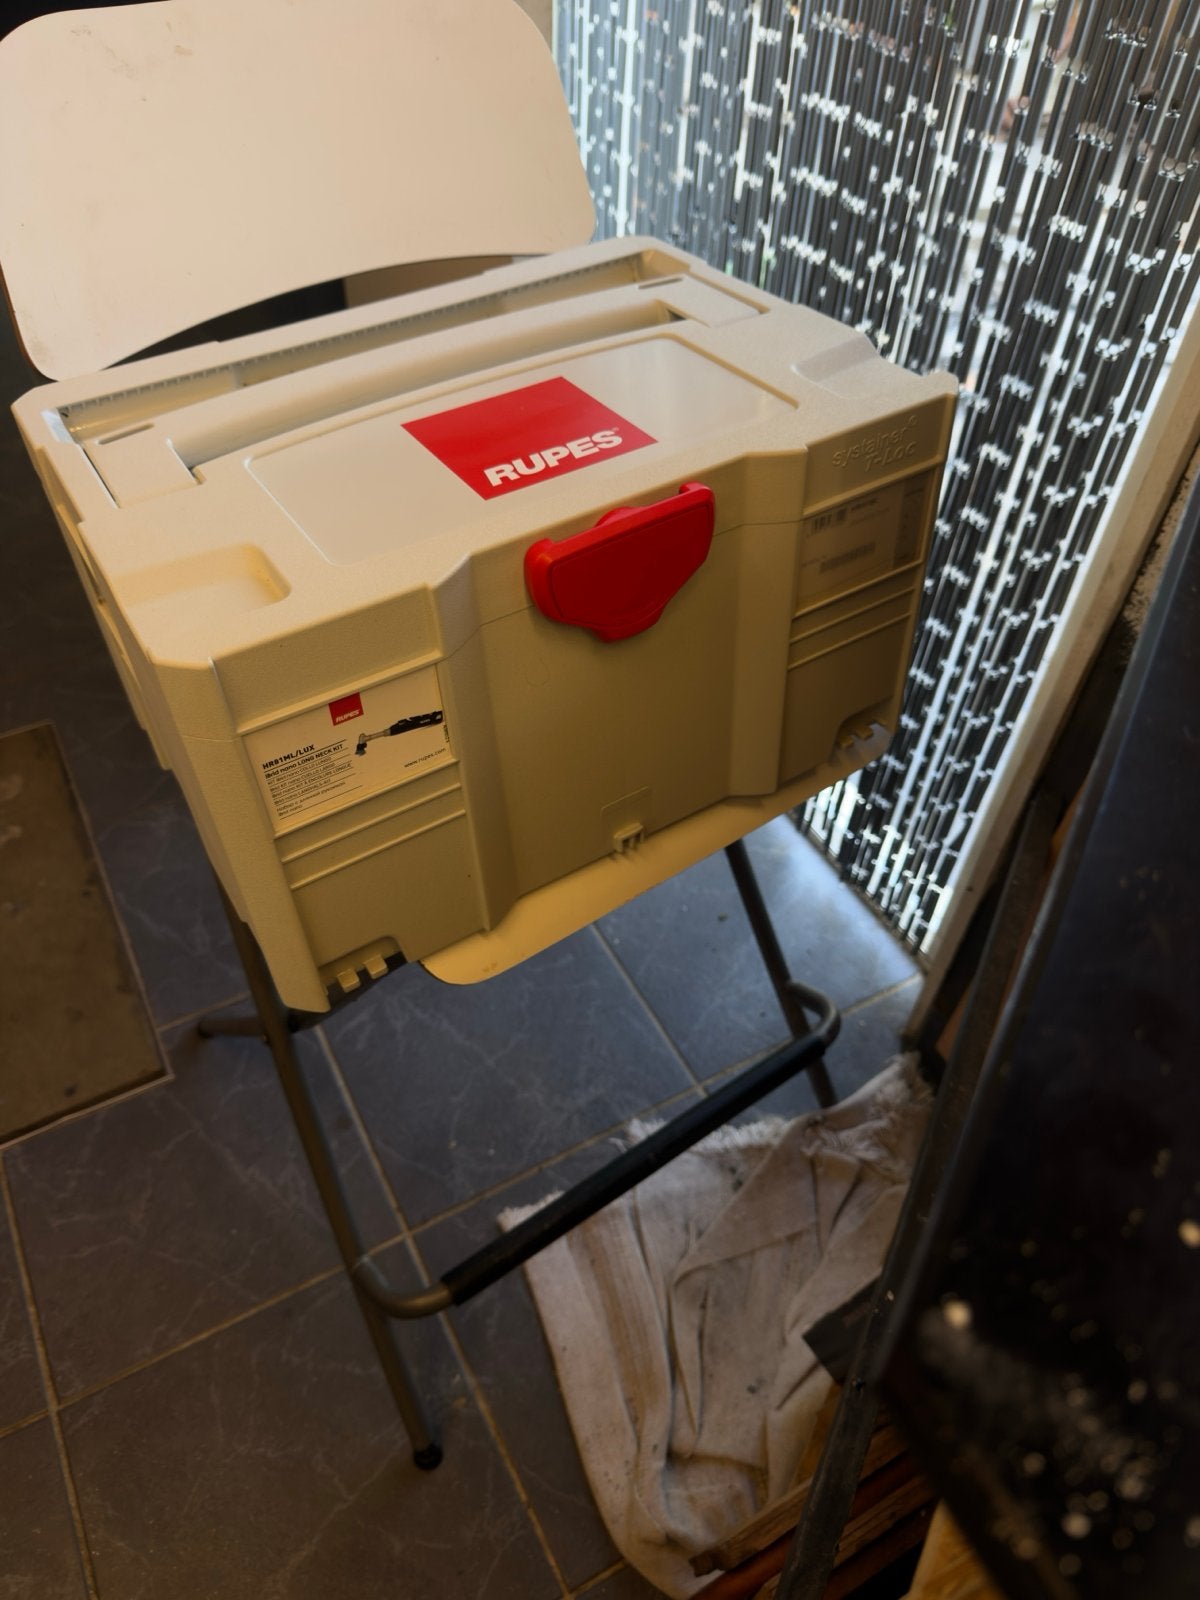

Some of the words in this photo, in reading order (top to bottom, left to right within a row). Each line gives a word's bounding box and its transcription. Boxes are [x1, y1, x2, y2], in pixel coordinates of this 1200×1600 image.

[484, 429, 622, 487] RUPES
[335, 709, 360, 723] RUPES
[263, 745, 315, 769] HR81ML/LUX
[280, 764, 297, 773] nano
[297, 756, 315, 766] LONG
[315, 749, 332, 759] NECK
